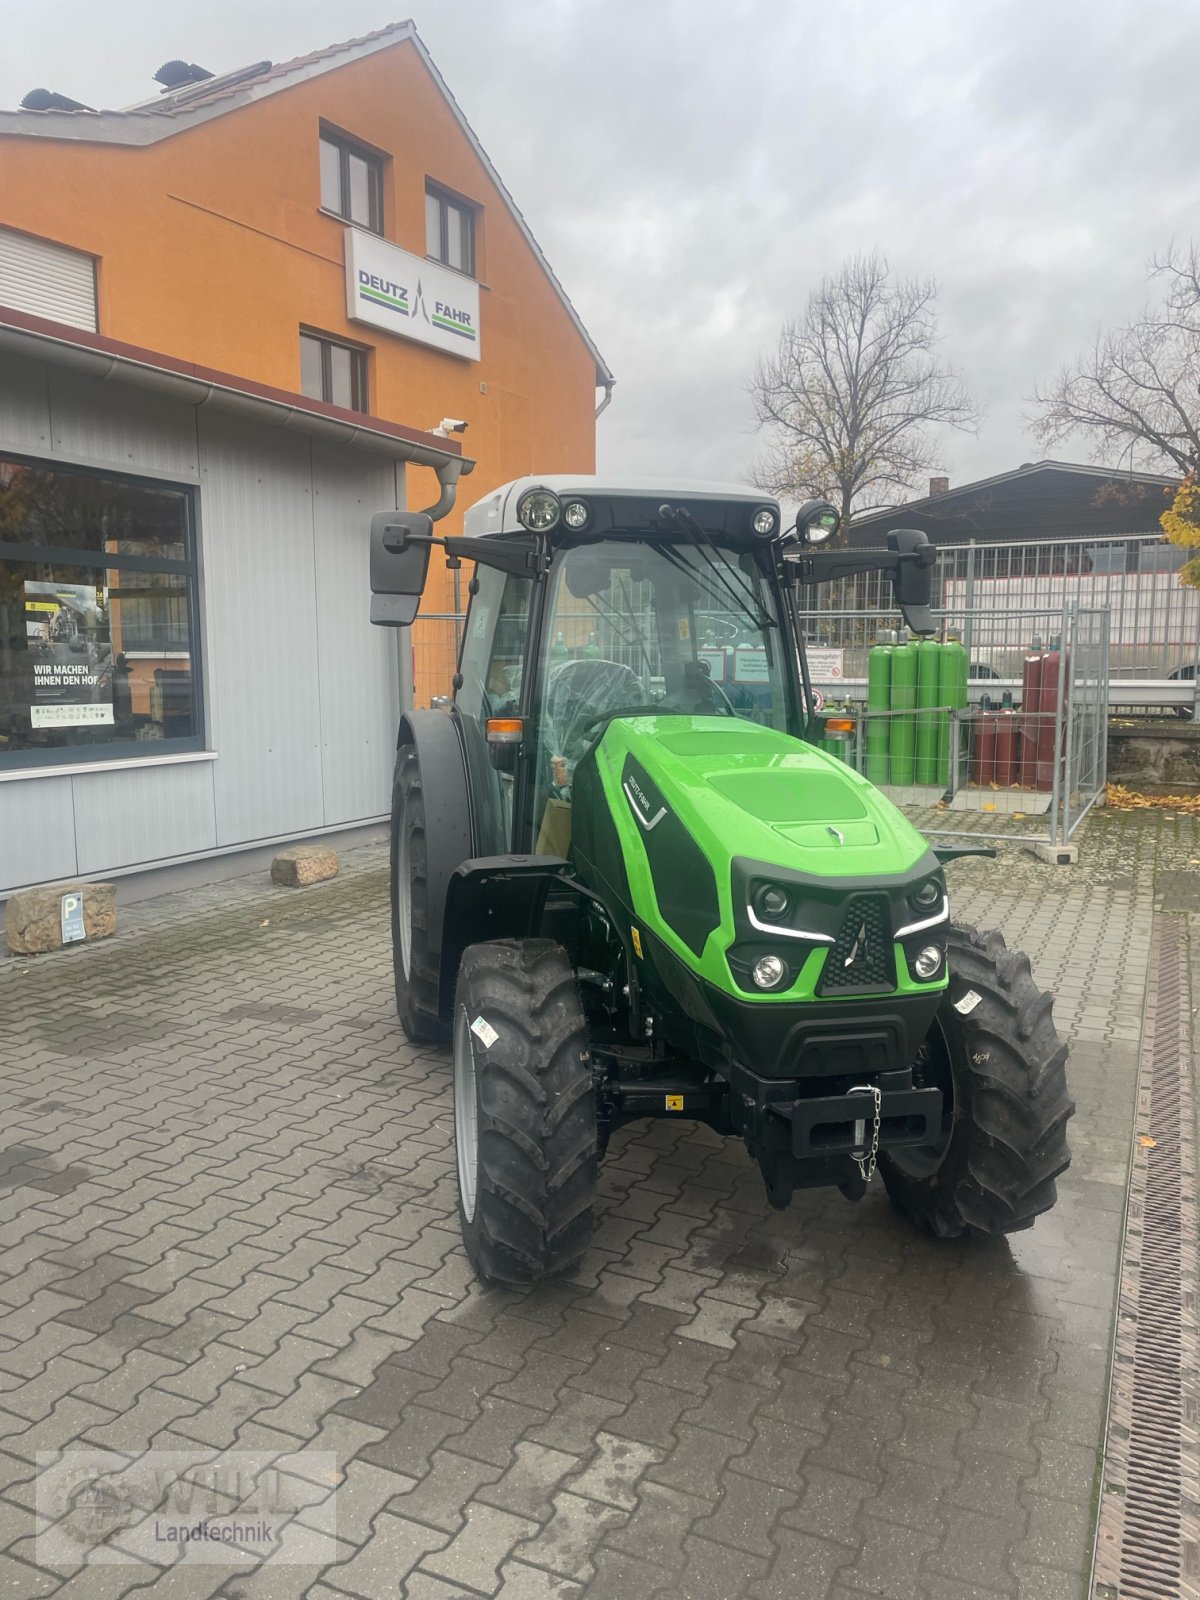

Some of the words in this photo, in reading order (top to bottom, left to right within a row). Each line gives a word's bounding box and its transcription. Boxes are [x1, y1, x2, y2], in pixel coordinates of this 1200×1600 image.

[359, 270, 409, 301] DEUTZ
[436, 302, 471, 326] FAHR
[33, 665, 52, 675] WIR
[53, 665, 89, 675] MACHEN
[34, 676, 62, 686] IHNEN
[62, 676, 81, 685] DEN
[65, 898, 77, 919] P
